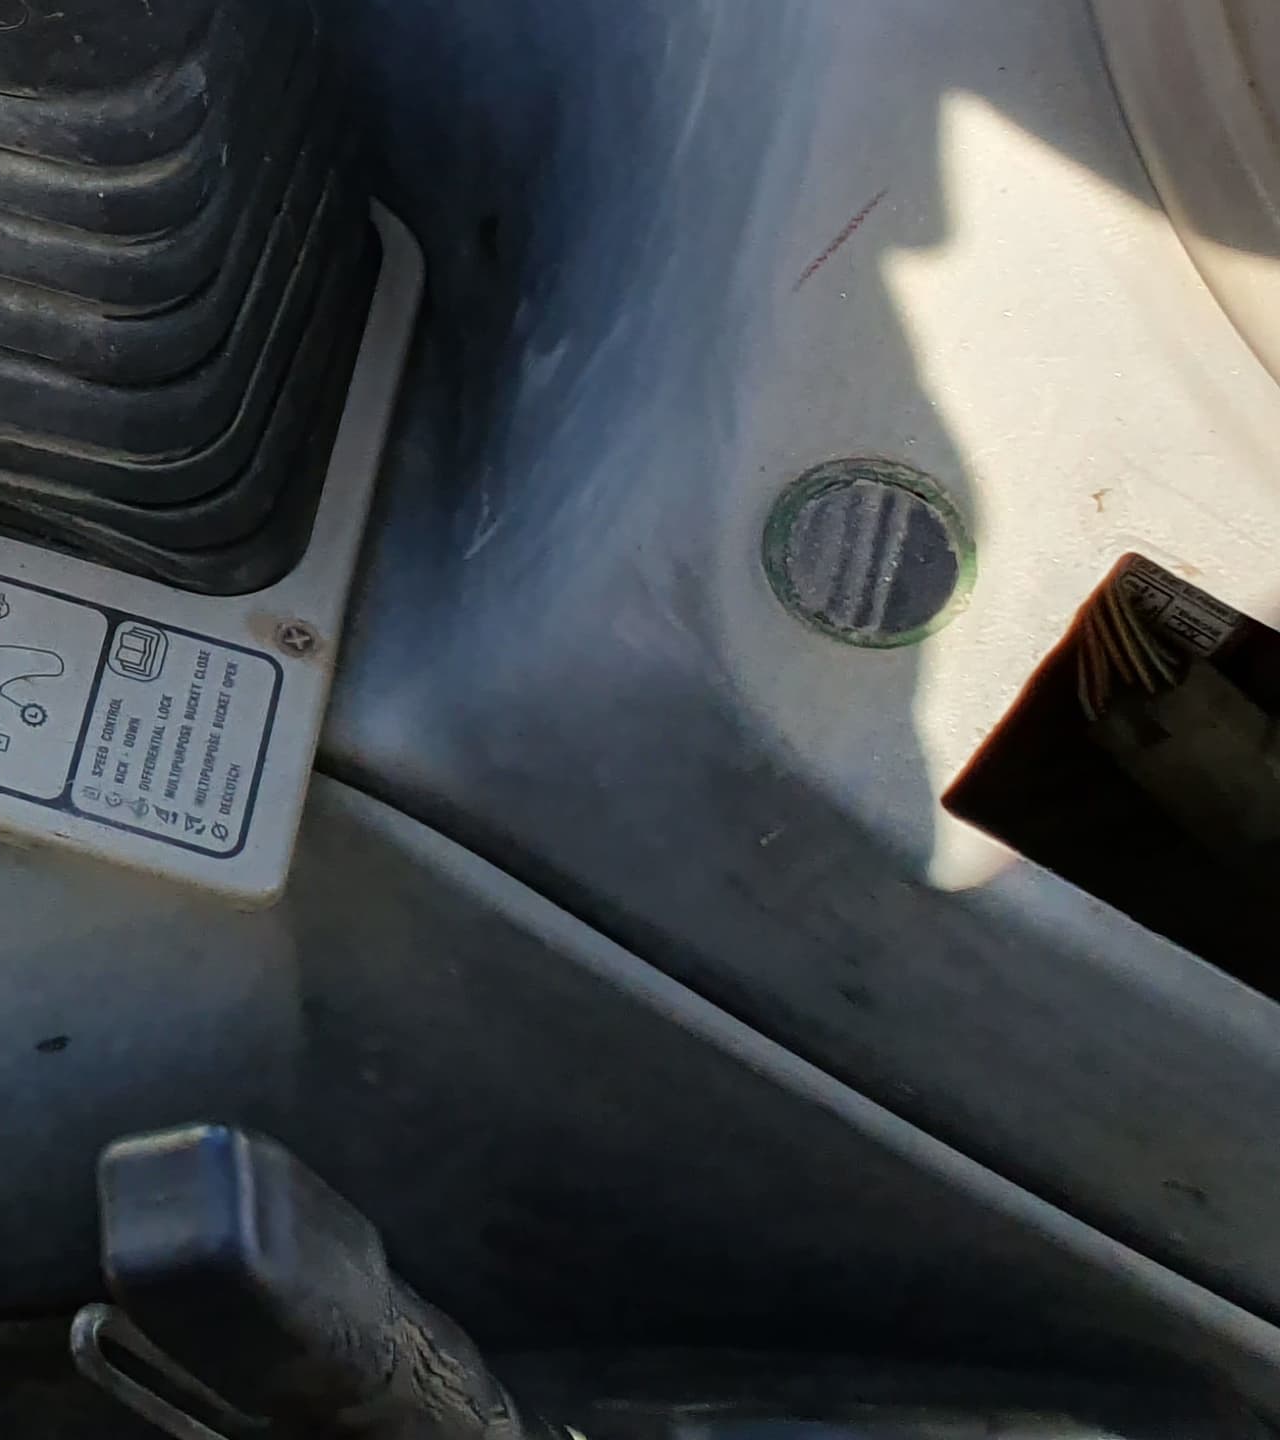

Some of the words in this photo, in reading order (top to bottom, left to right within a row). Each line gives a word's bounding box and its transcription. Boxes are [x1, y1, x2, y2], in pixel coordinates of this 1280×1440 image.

[164, 725, 193, 800] MULTIPURPOSE
[184, 683, 203, 721] BUCKET
[194, 649, 211, 680] CLOSE
[212, 691, 231, 730] BUCKET
[222, 661, 239, 689] OPEN
[91, 746, 109, 778] SPEED
[101, 698, 124, 742] CONTROL
[114, 761, 129, 785] KICK
[123, 717, 141, 748] DOWN
[139, 725, 166, 792] DIFFERENTIAL
[157, 693, 173, 720] LOCK
[219, 762, 240, 816] DECLUTCH
